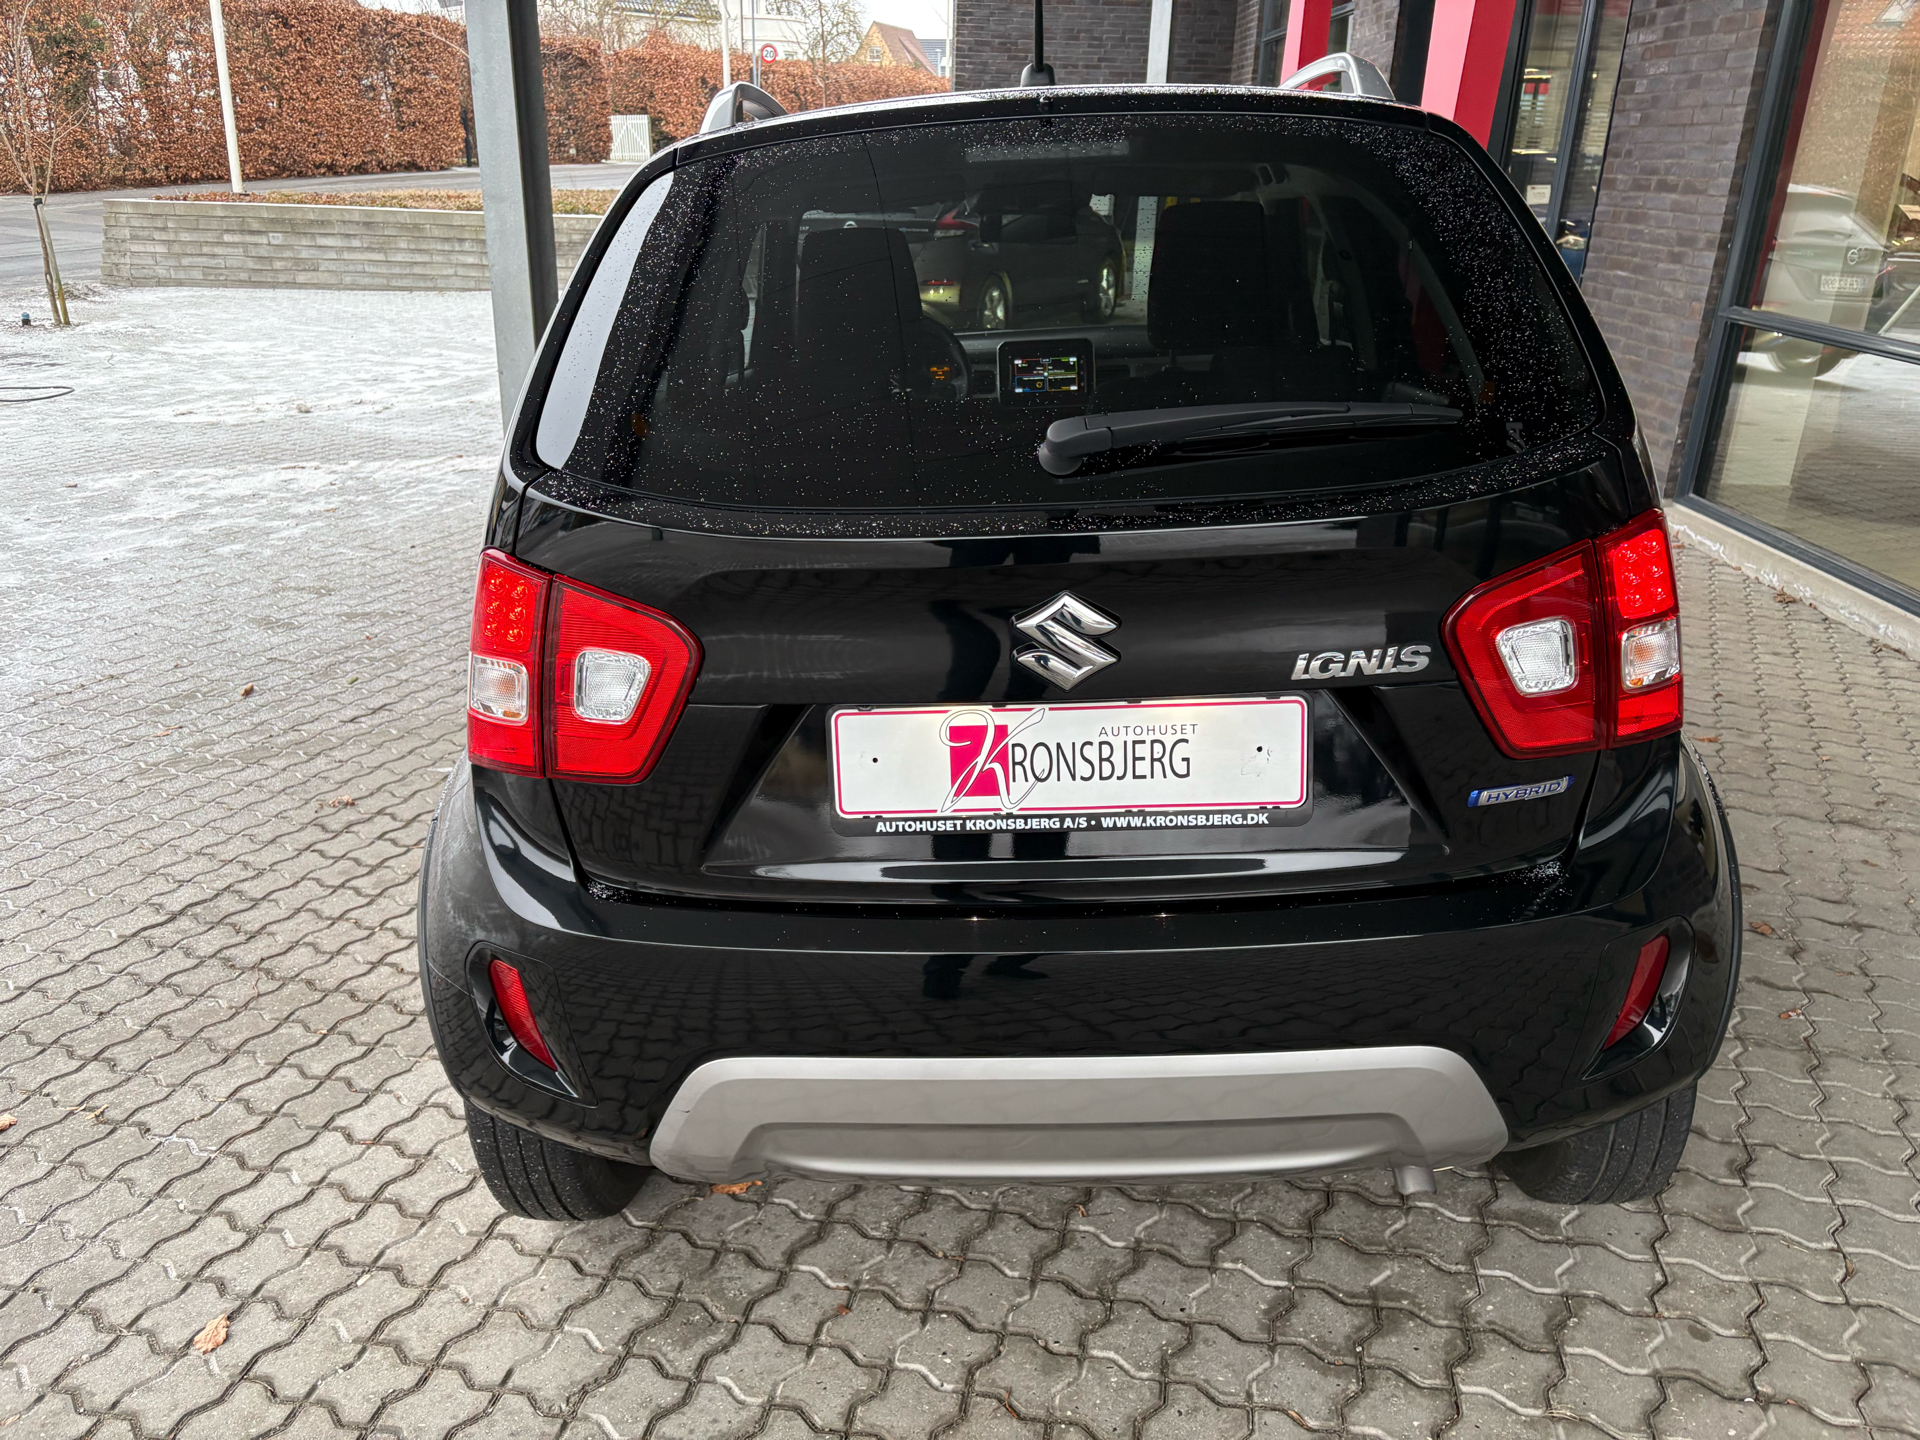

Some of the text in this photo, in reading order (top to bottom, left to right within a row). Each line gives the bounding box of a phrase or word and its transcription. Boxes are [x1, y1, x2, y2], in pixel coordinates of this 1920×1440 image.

[764, 49, 775, 58] 20
[1291, 645, 1431, 680] IGNIS
[1098, 723, 1199, 738] AUTOHUSET
[1486, 782, 1562, 803] HYBRID
[876, 812, 1269, 833] AUTOHUSET KRONSBJERG A/S WWW.KRONSBJERG.DK
